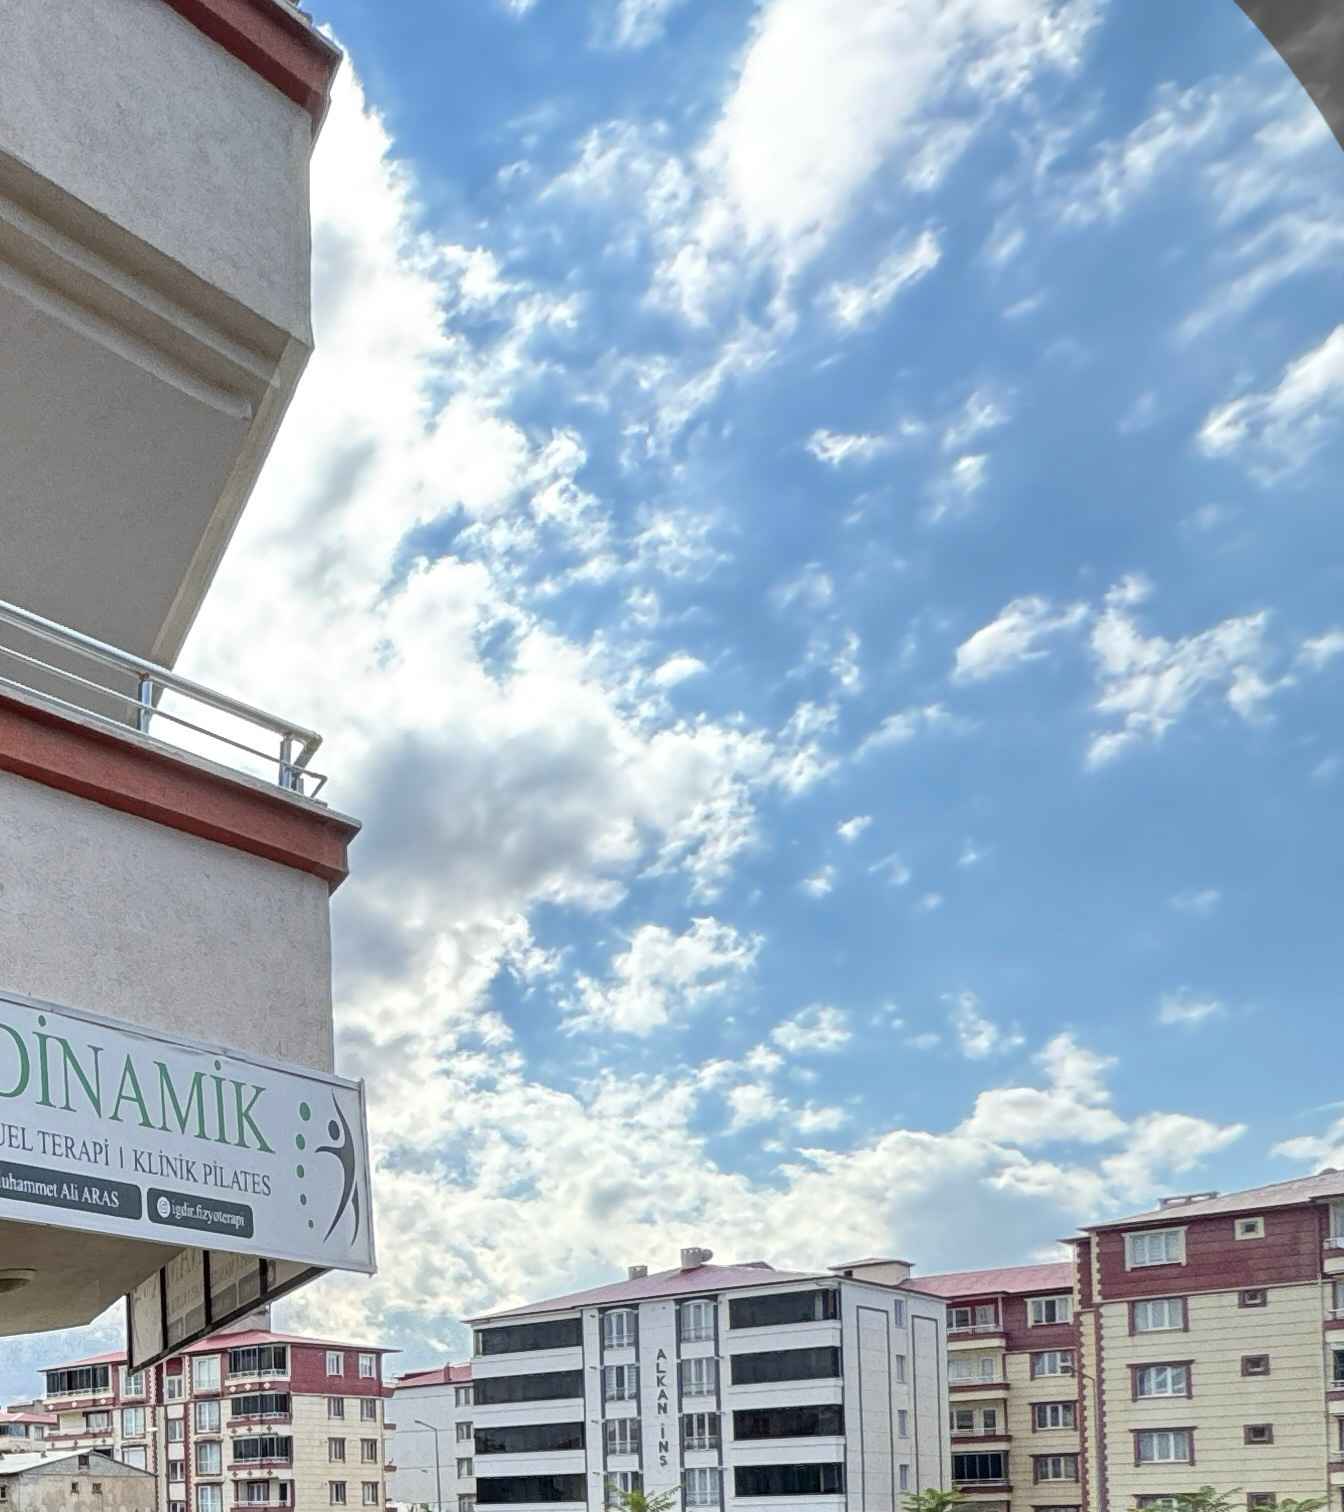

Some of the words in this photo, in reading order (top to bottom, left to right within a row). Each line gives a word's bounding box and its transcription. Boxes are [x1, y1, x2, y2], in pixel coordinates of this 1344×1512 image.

[37, 1130, 110, 1167] TERAPİ
[133, 1149, 199, 1184] KLİNİK
[202, 1160, 272, 1197] PİLATES
[60, 1183, 79, 1202] Ali
[81, 1186, 120, 1208] ARAS
[655, 1347, 669, 1415] ALKAN
